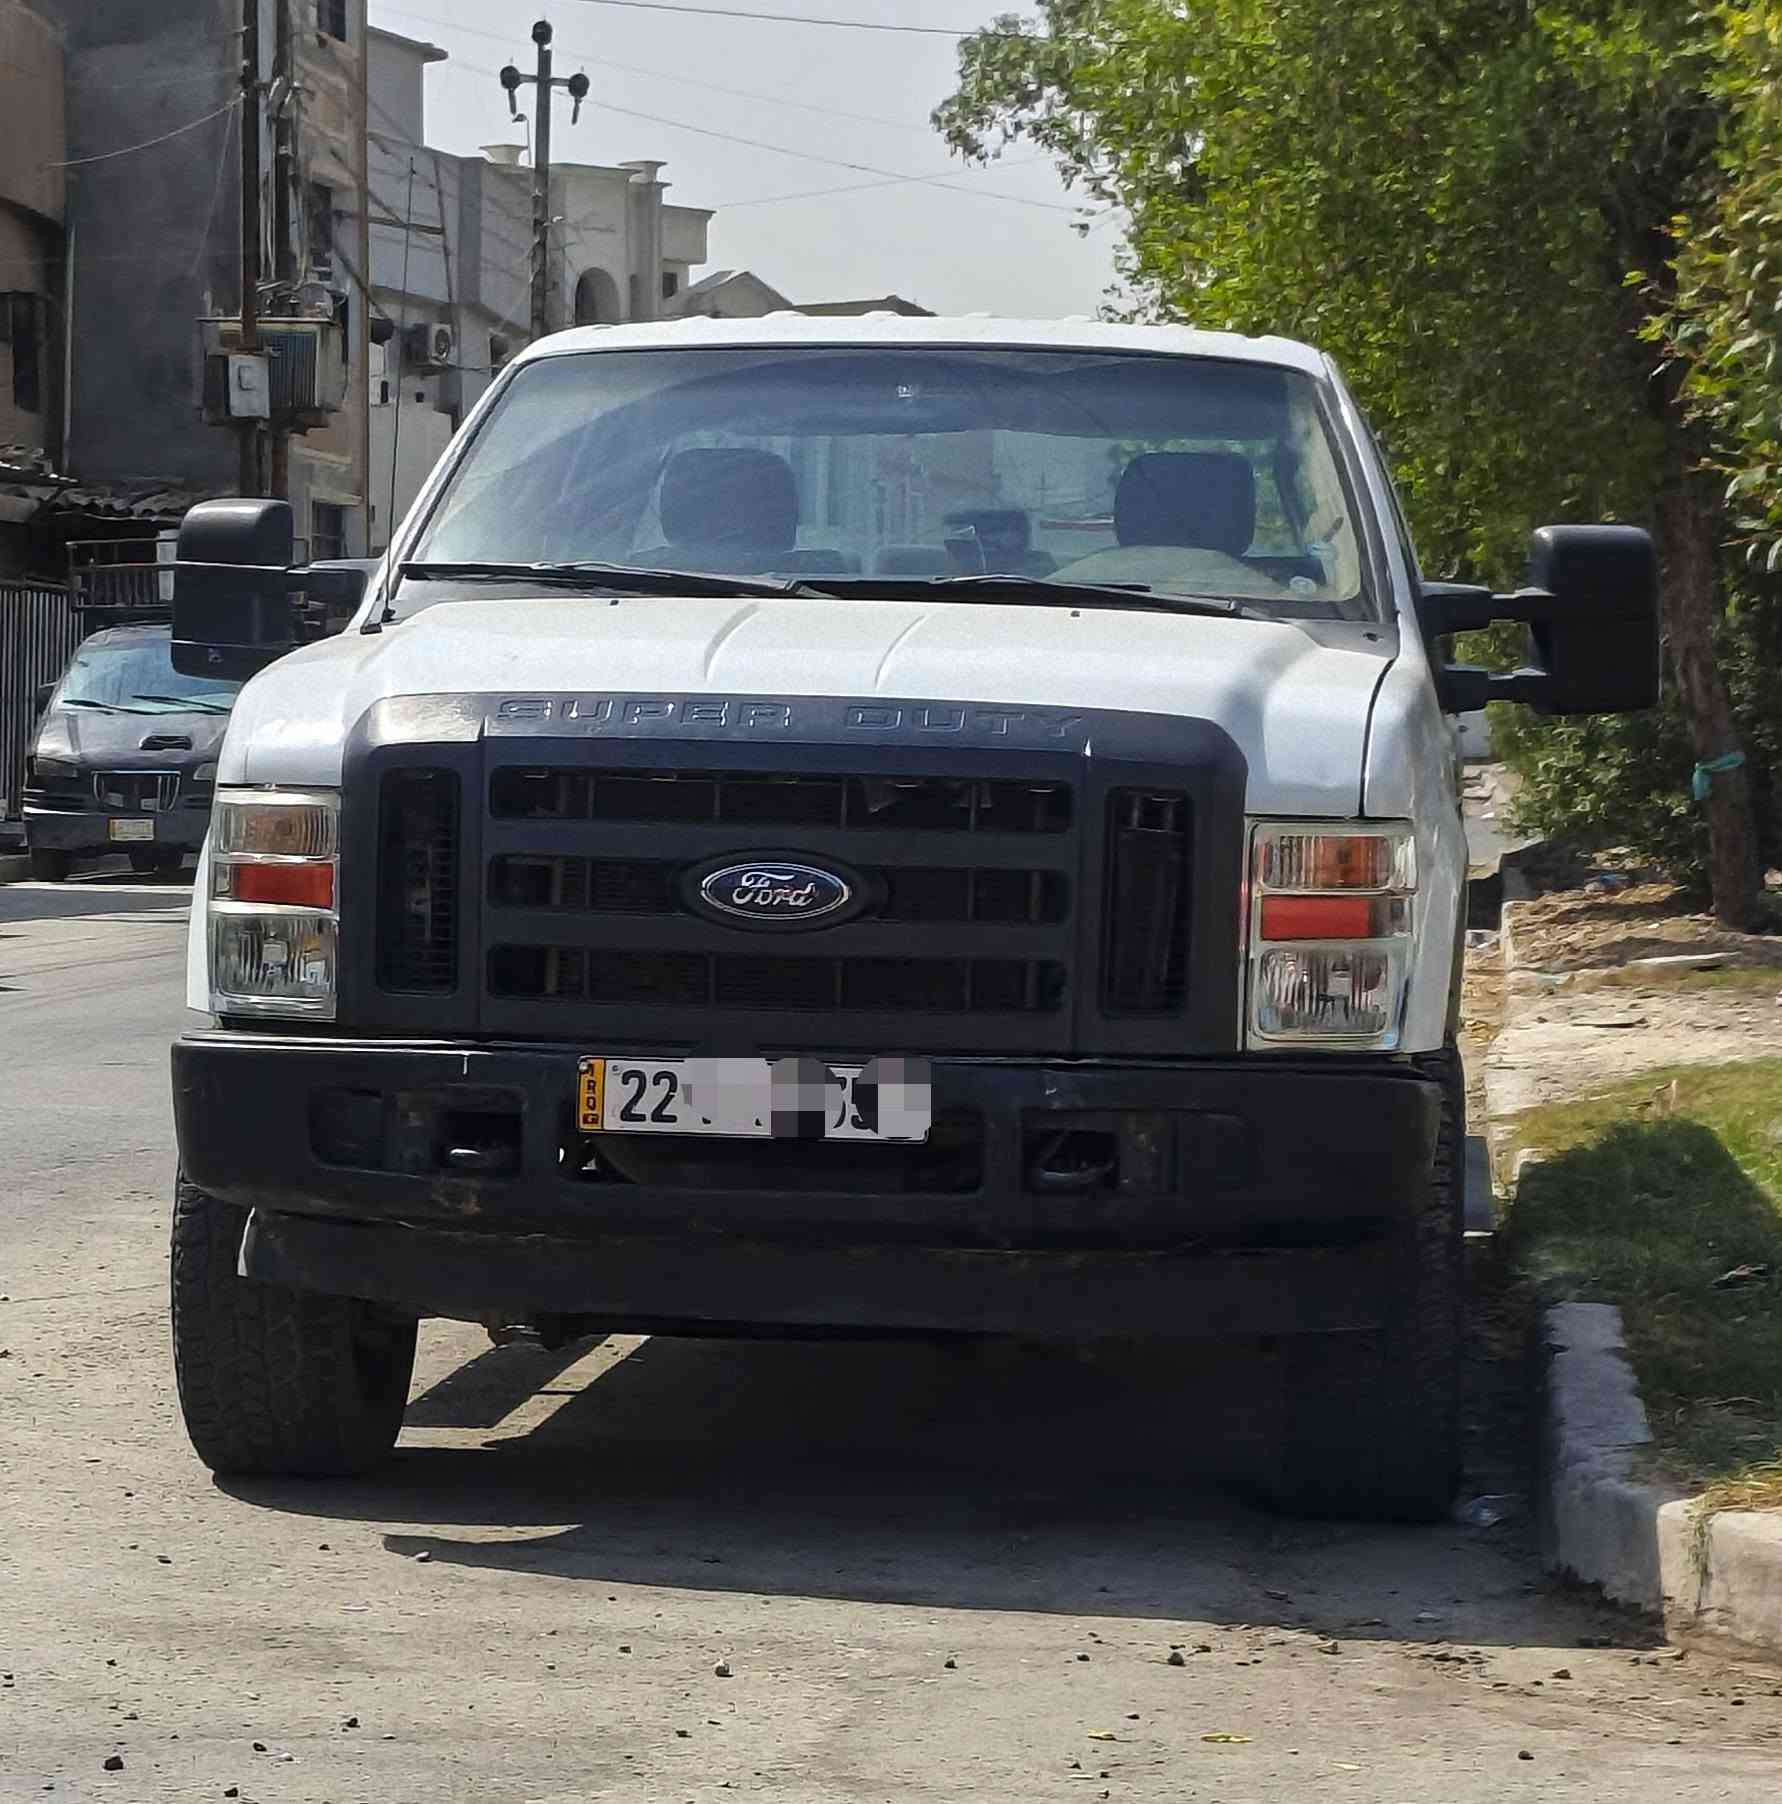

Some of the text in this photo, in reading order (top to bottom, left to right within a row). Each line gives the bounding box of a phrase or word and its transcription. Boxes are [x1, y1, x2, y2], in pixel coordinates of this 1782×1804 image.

[498, 699, 1084, 738] SUPER DUTY
[732, 871, 816, 906] Ford
